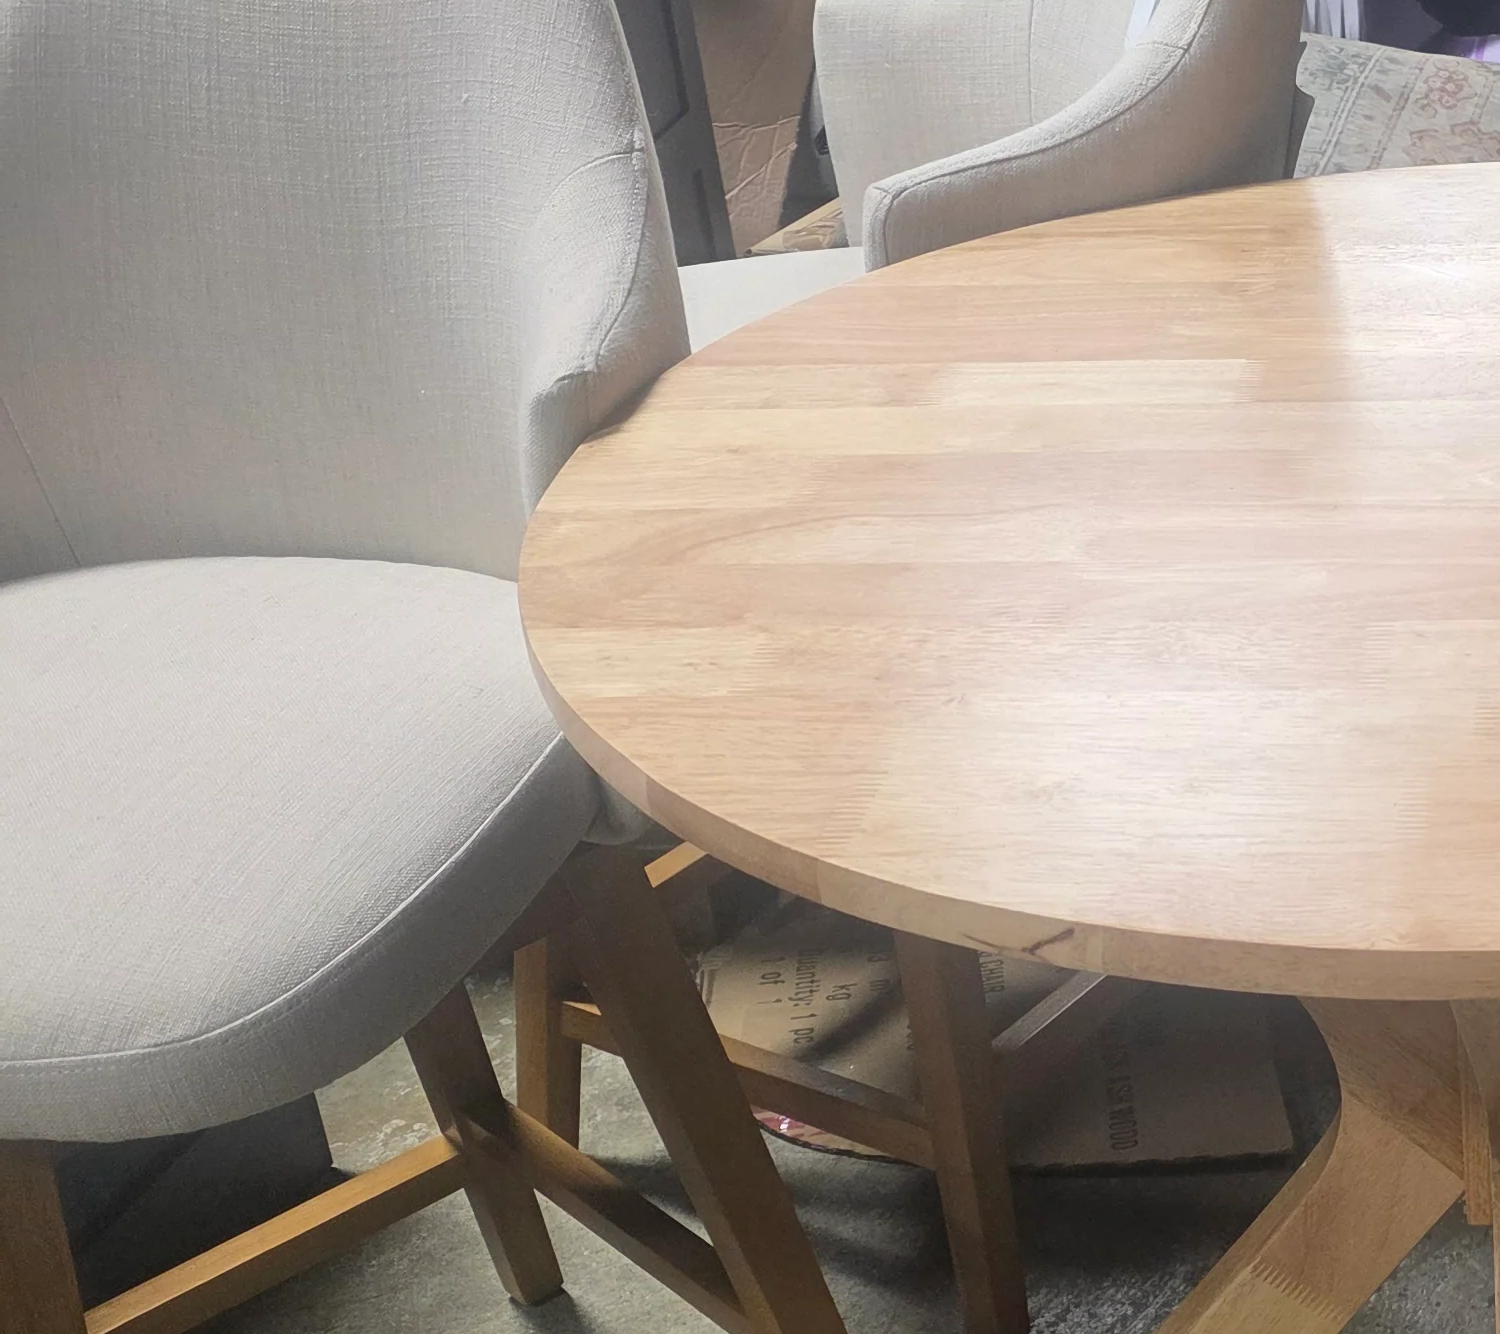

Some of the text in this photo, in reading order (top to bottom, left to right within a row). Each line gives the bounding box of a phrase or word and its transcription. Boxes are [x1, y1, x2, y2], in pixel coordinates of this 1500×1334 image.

[758, 971, 786, 986] of
[825, 982, 858, 1002] kg
[788, 1026, 815, 1045] pc
